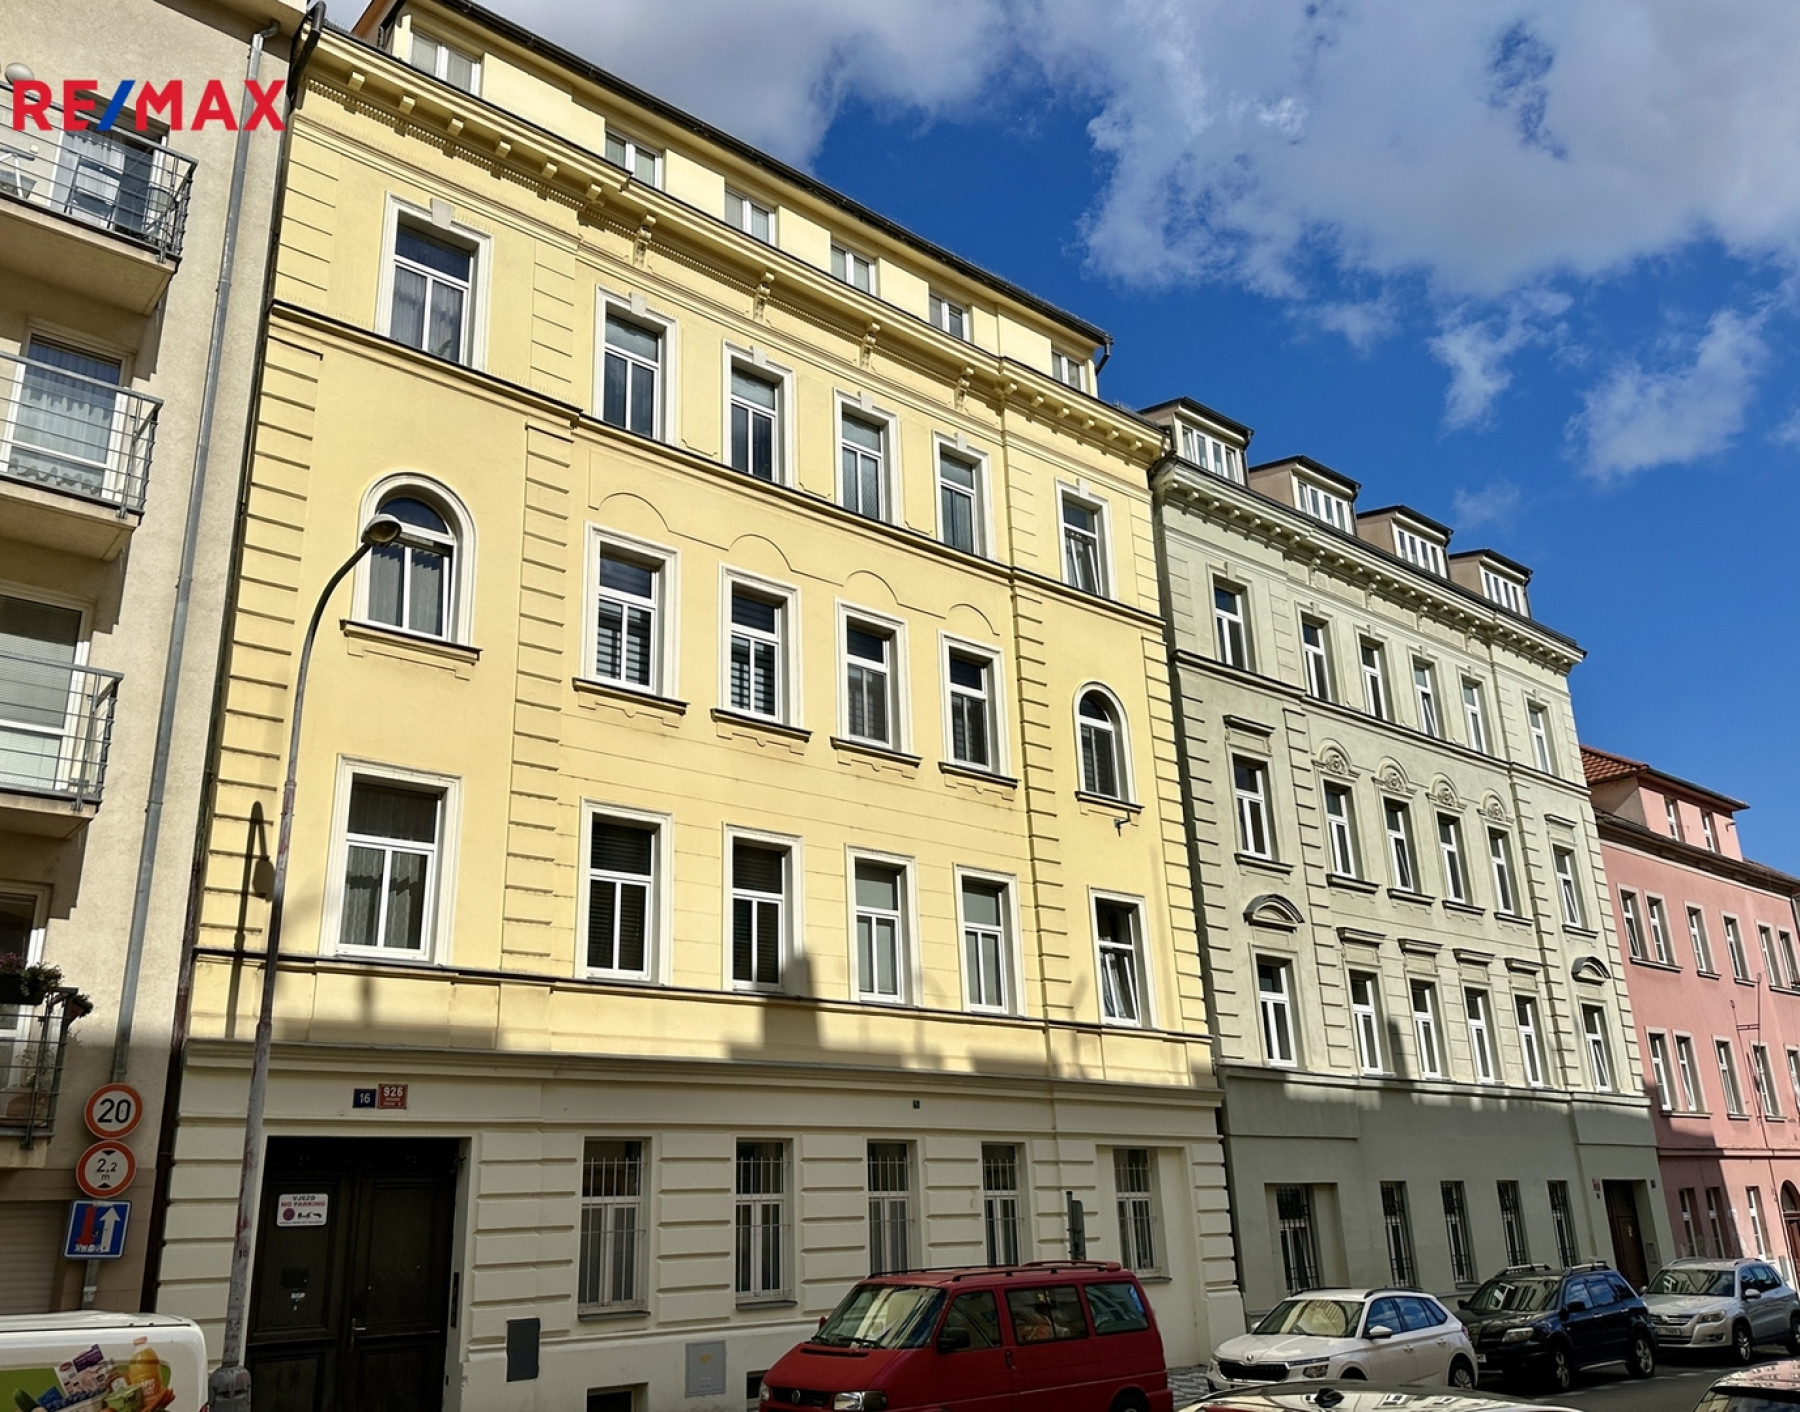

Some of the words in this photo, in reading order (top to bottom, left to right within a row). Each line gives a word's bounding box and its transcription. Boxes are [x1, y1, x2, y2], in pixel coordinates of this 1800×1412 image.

[383, 1086, 404, 1098] 926
[360, 1092, 371, 1105] 16
[97, 1098, 131, 1124] 20
[101, 1173, 111, 1181] m
